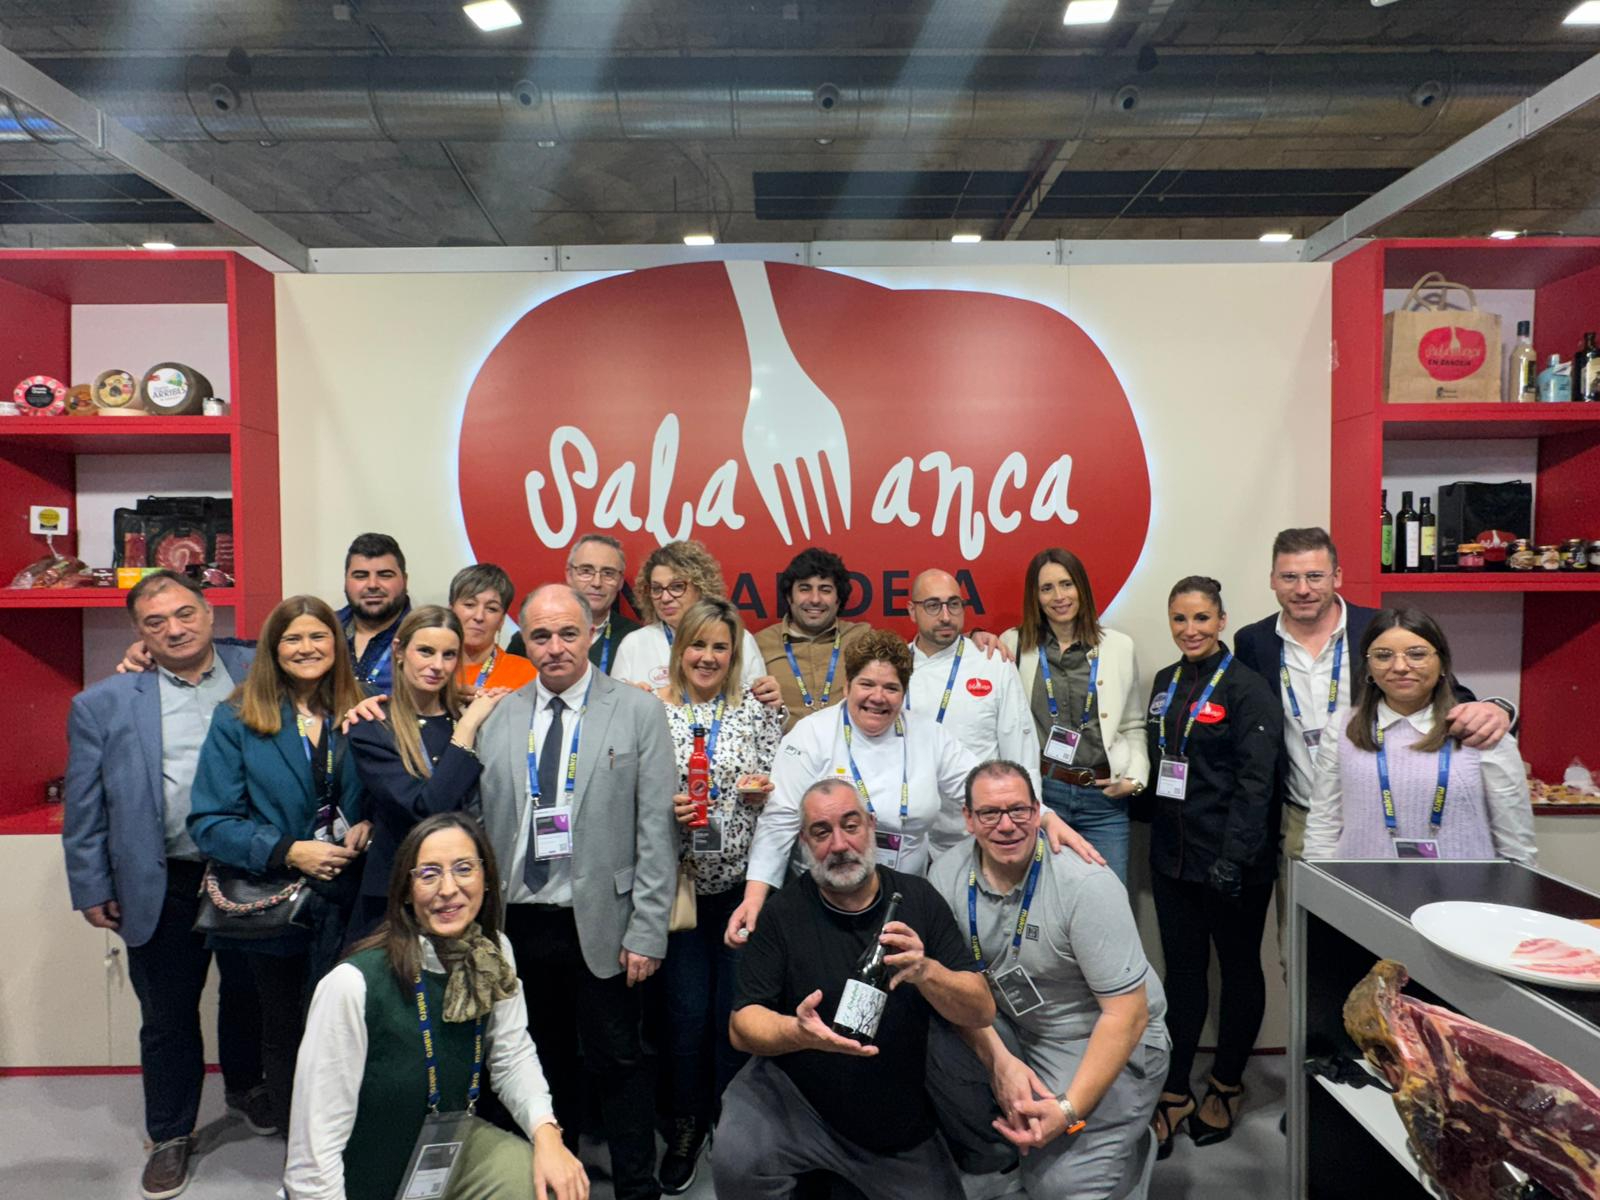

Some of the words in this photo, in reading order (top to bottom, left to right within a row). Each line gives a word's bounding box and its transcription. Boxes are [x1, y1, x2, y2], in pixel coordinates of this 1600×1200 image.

[525, 413, 1078, 561] Salamanca
[567, 753, 578, 779] makro
[1383, 789, 1395, 817] makro
[1434, 786, 1445, 813] makro
[1015, 908, 1028, 935] makro
[971, 935, 982, 961] makro
[416, 992, 427, 1021] makro
[422, 1029, 433, 1059] makro
[472, 1072, 480, 1088] kro
